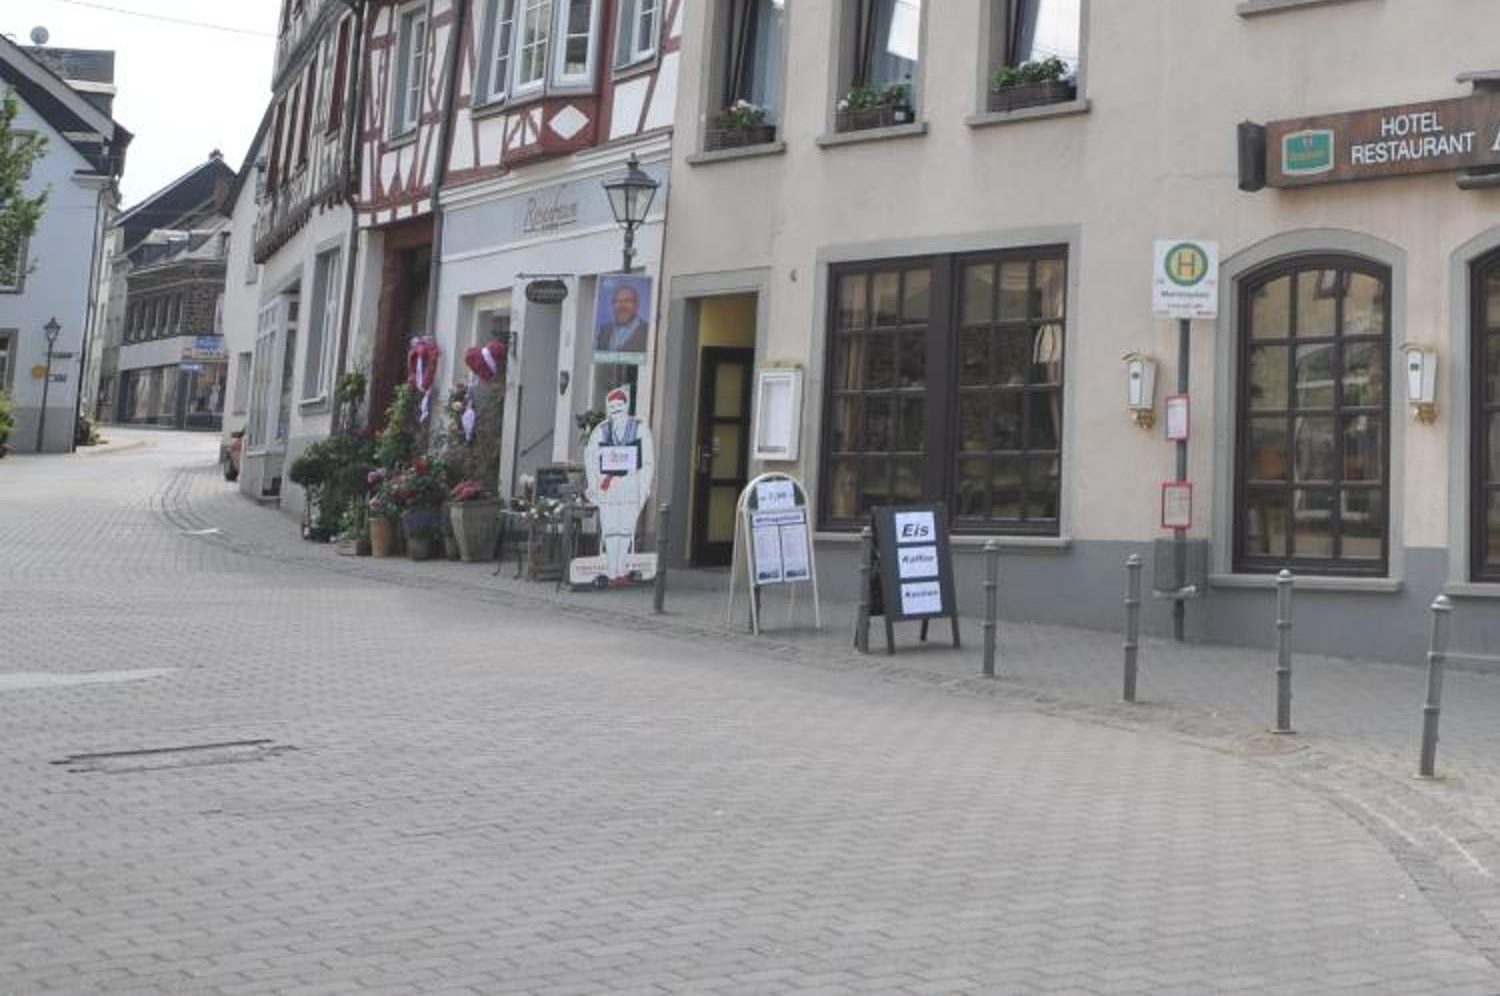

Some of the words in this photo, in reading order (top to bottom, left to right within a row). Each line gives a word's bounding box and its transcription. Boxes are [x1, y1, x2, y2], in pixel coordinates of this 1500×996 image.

[1381, 111, 1443, 137] HOTEL
[1351, 131, 1476, 165] RESTAURANT
[1177, 251, 1197, 277] H
[901, 523, 930, 538] Eis
